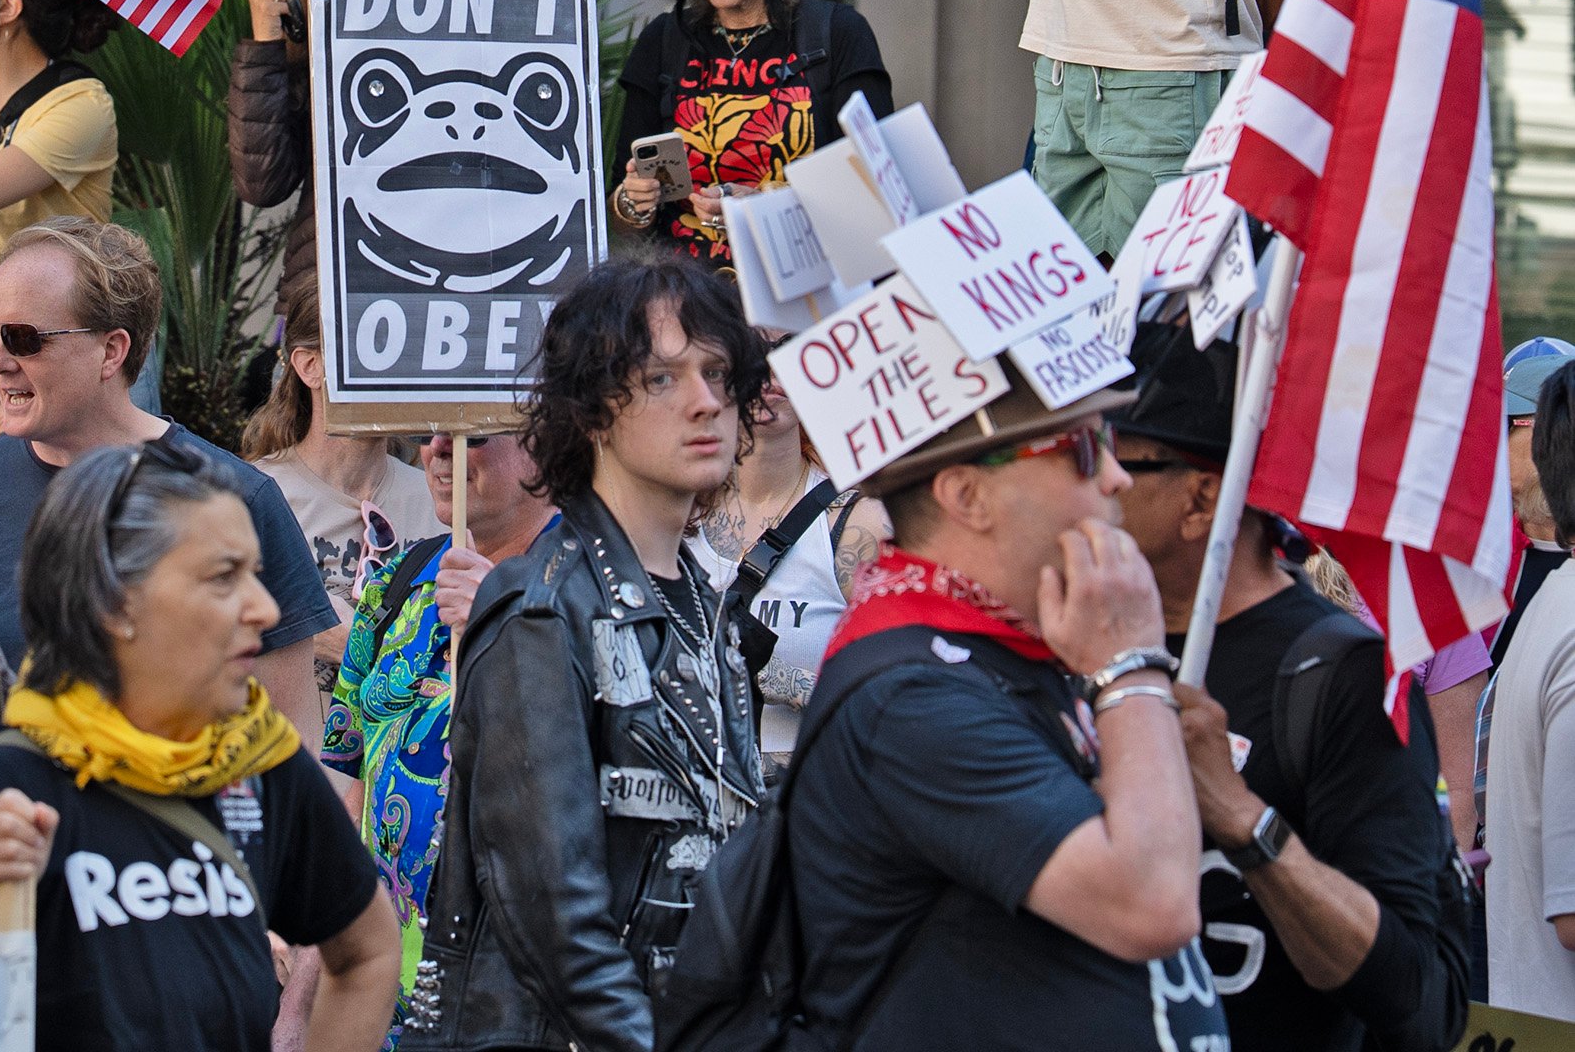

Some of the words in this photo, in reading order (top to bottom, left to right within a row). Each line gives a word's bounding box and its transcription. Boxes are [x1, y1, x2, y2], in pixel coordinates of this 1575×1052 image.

[939, 202, 1002, 261] NO
[1168, 172, 1219, 224] NO
[959, 242, 1087, 332] KINGS
[799, 294, 937, 389] OPEN
[861, 342, 930, 408] THE
[845, 356, 988, 471] FILES
[64, 840, 256, 933] Resis
